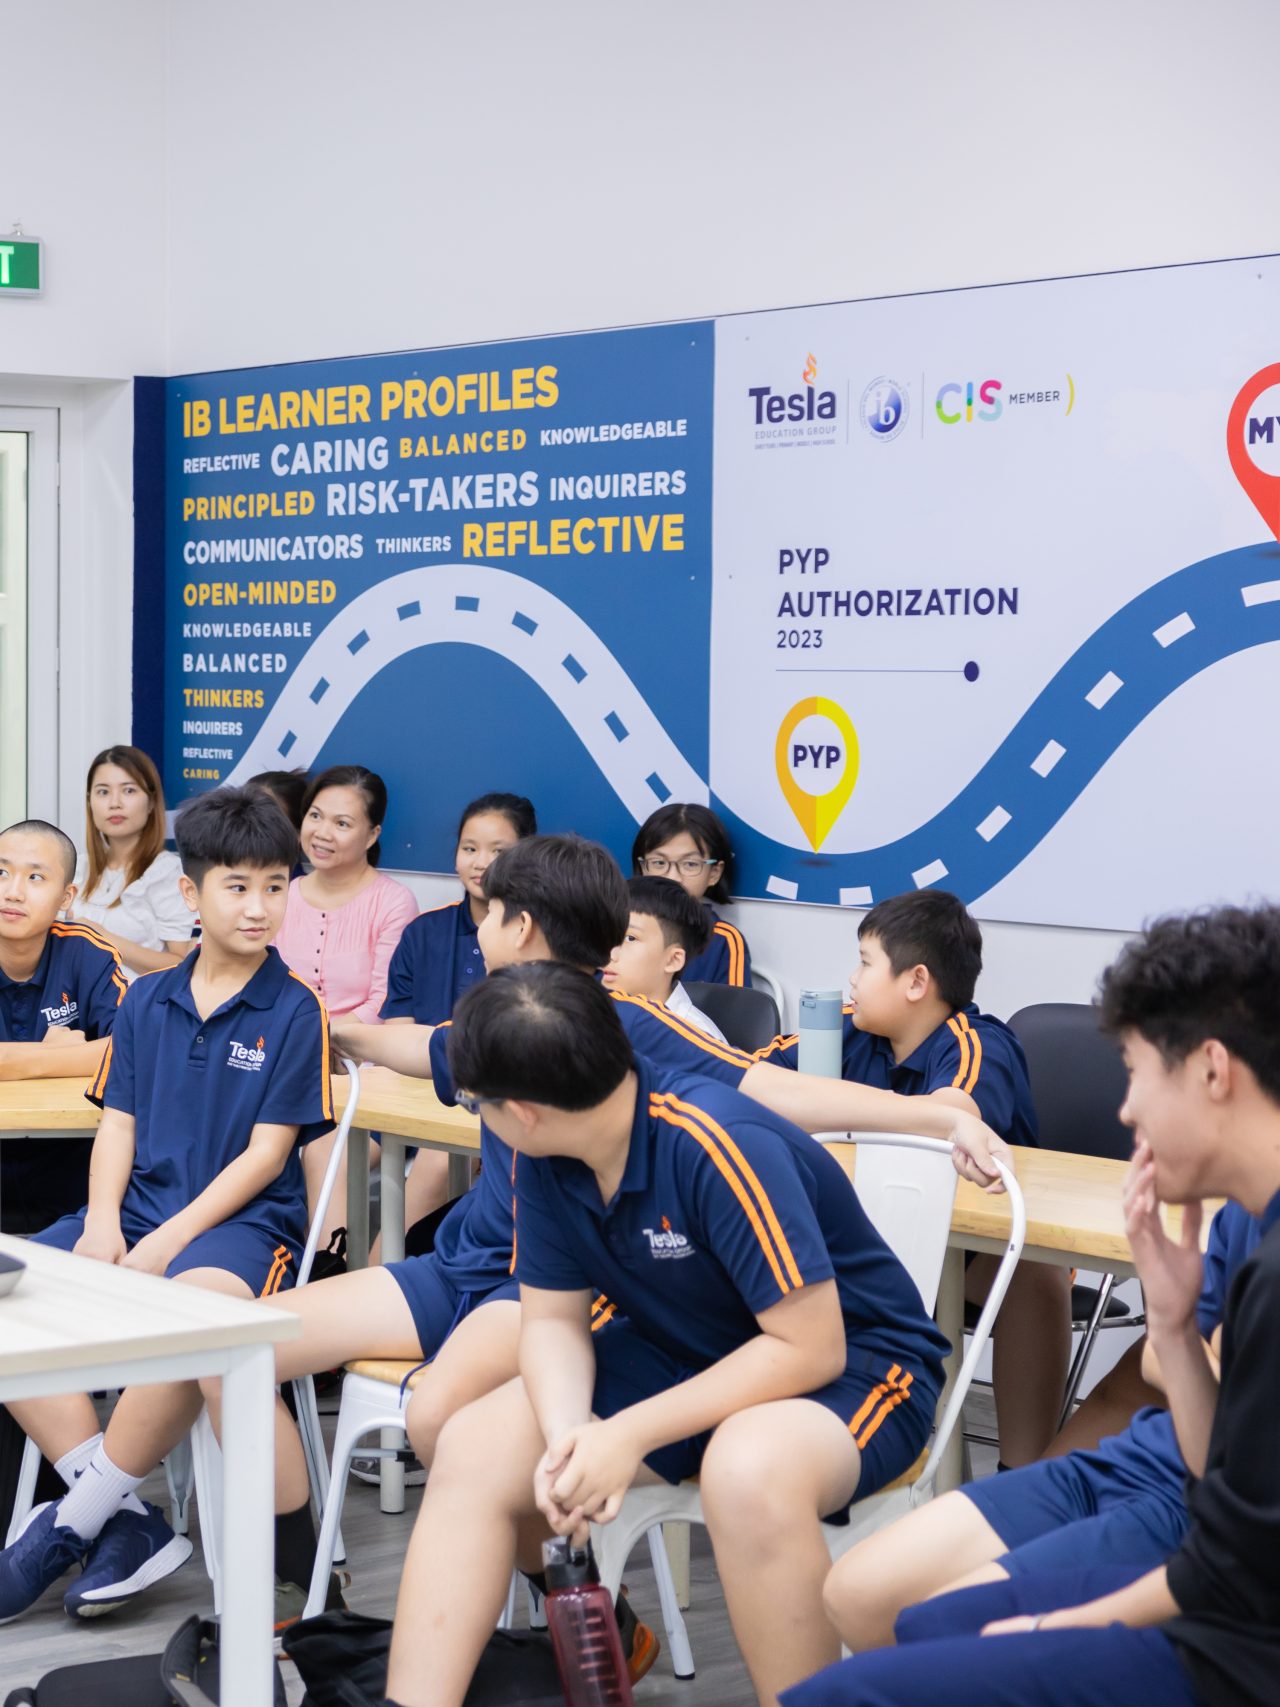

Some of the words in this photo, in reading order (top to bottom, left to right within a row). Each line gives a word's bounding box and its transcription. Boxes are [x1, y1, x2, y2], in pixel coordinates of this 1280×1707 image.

[181, 401, 211, 437] IB
[220, 386, 370, 433] LEARNER
[381, 367, 559, 419] PROFILES
[749, 387, 836, 423] Tesla
[936, 380, 1002, 424] CIS
[1010, 391, 1059, 404] MEMBER
[755, 428, 803, 439] EDUCATION
[808, 425, 838, 436] GROUP
[184, 454, 260, 473] REFLECTIVE
[271, 438, 388, 475] CARING
[400, 430, 526, 457] BALANCED
[541, 420, 687, 445] KNOWLEDGEABLE
[184, 492, 315, 520] PRINCIPLED
[327, 473, 539, 515] RISK-TAKERS
[550, 471, 686, 500] INQUIRERS
[181, 535, 363, 563] COMMUNICATORS
[376, 536, 451, 553] THINKERS
[463, 515, 684, 556] REFLECTIVE
[780, 548, 829, 574] PYP
[184, 581, 336, 605] OPEN-MINDED
[778, 589, 1018, 616] AUTHORIZATION
[182, 623, 312, 637] KNOWLEDGEABLE
[777, 630, 822, 648] 2023
[184, 654, 287, 673] BALANCED
[184, 690, 264, 708] THINKERS
[184, 722, 243, 735] INQUIRERS
[184, 748, 233, 759] REFLECTIVE
[794, 745, 840, 768] PYP
[184, 769, 220, 780] CARING
[40, 1002, 77, 1021] Tesla
[230, 1041, 266, 1062] Tesla
[642, 1228, 688, 1248] Tesla
